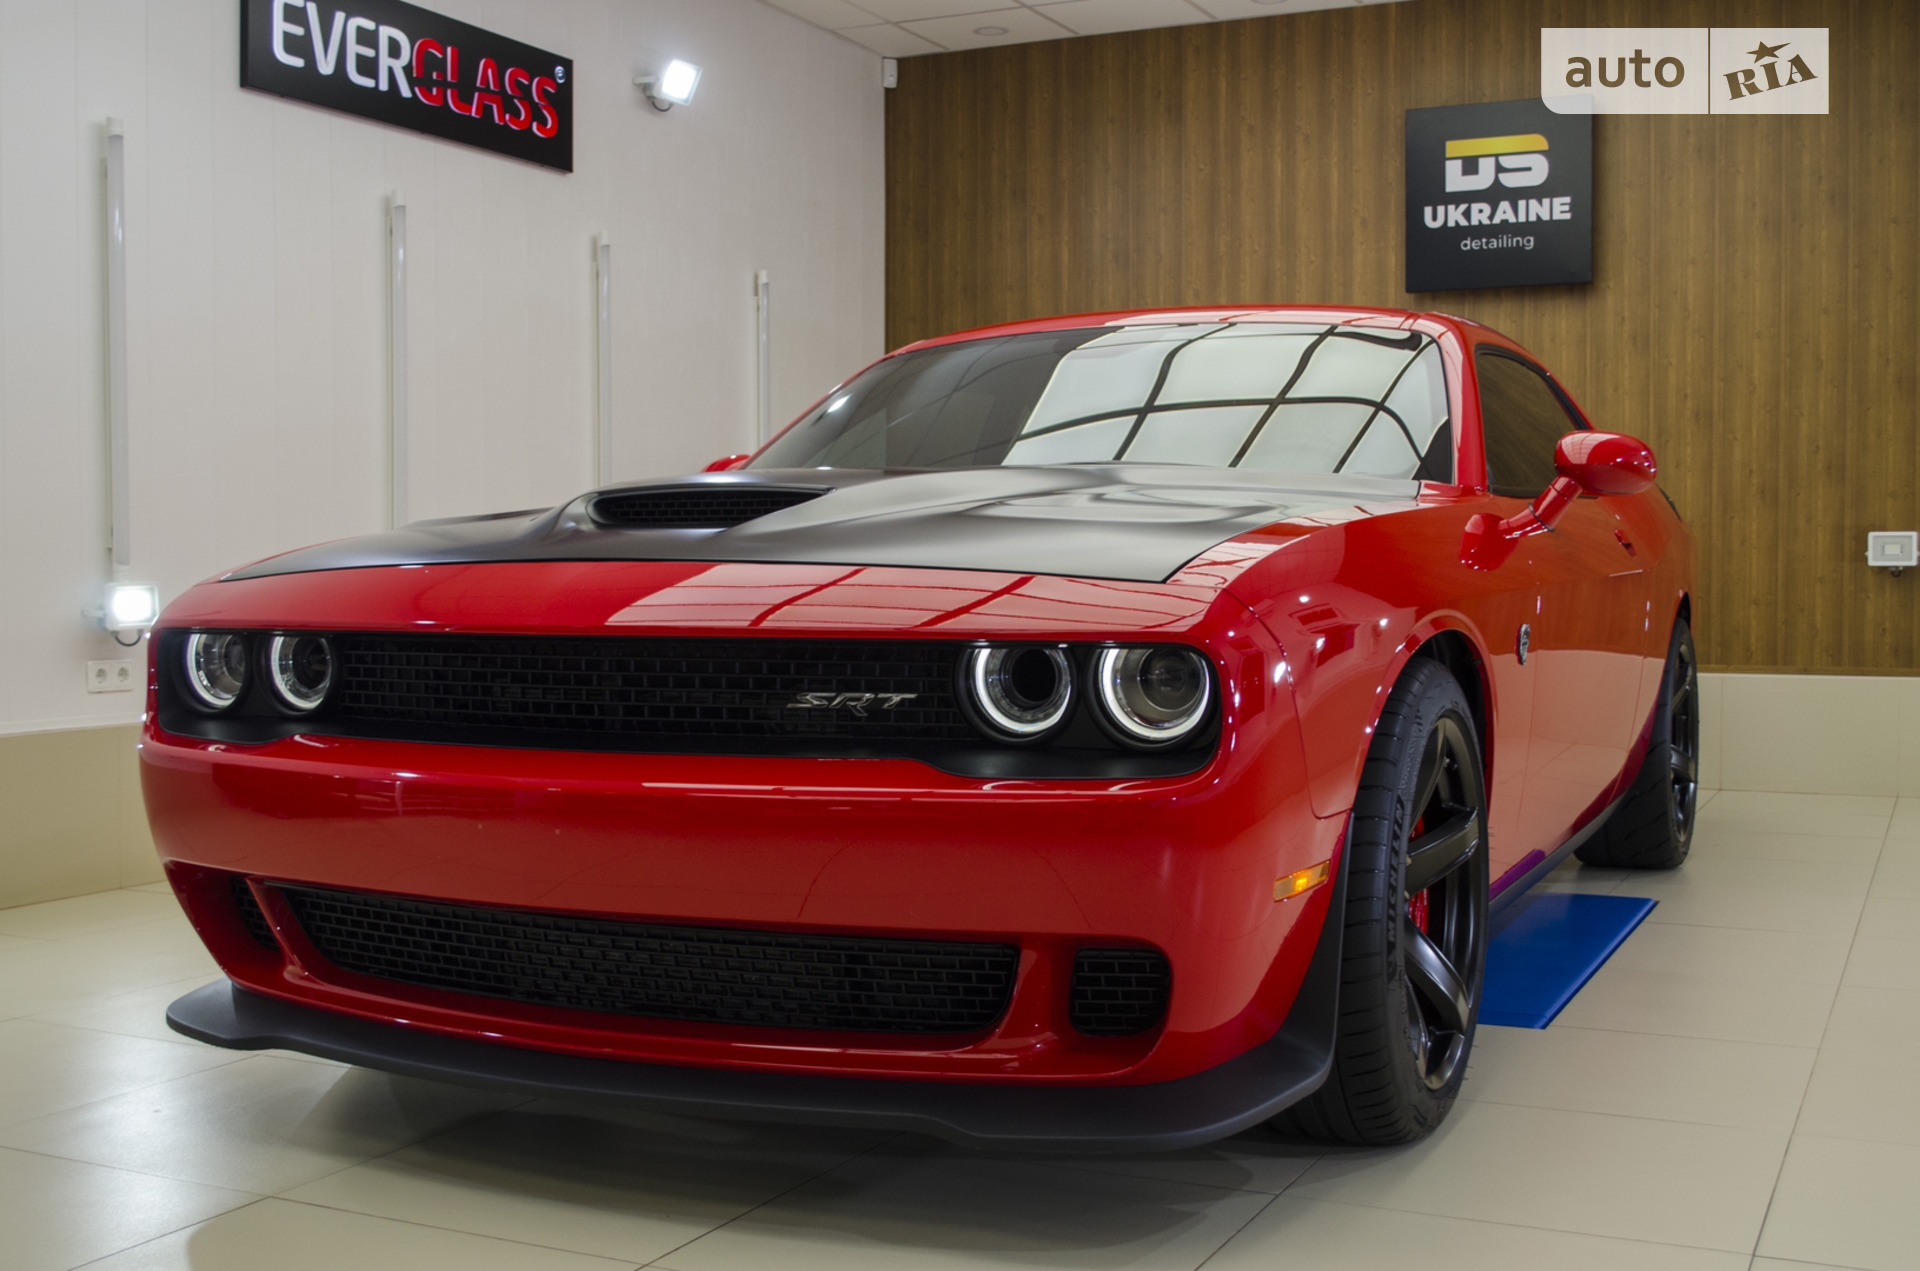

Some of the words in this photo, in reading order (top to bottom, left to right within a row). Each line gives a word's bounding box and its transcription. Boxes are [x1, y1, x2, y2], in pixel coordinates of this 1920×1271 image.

[1424, 196, 1572, 229] UKRAINE
[1460, 234, 1535, 251] detailing
[786, 692, 918, 717] SRT
[1388, 803, 1404, 942] MICHELIN
